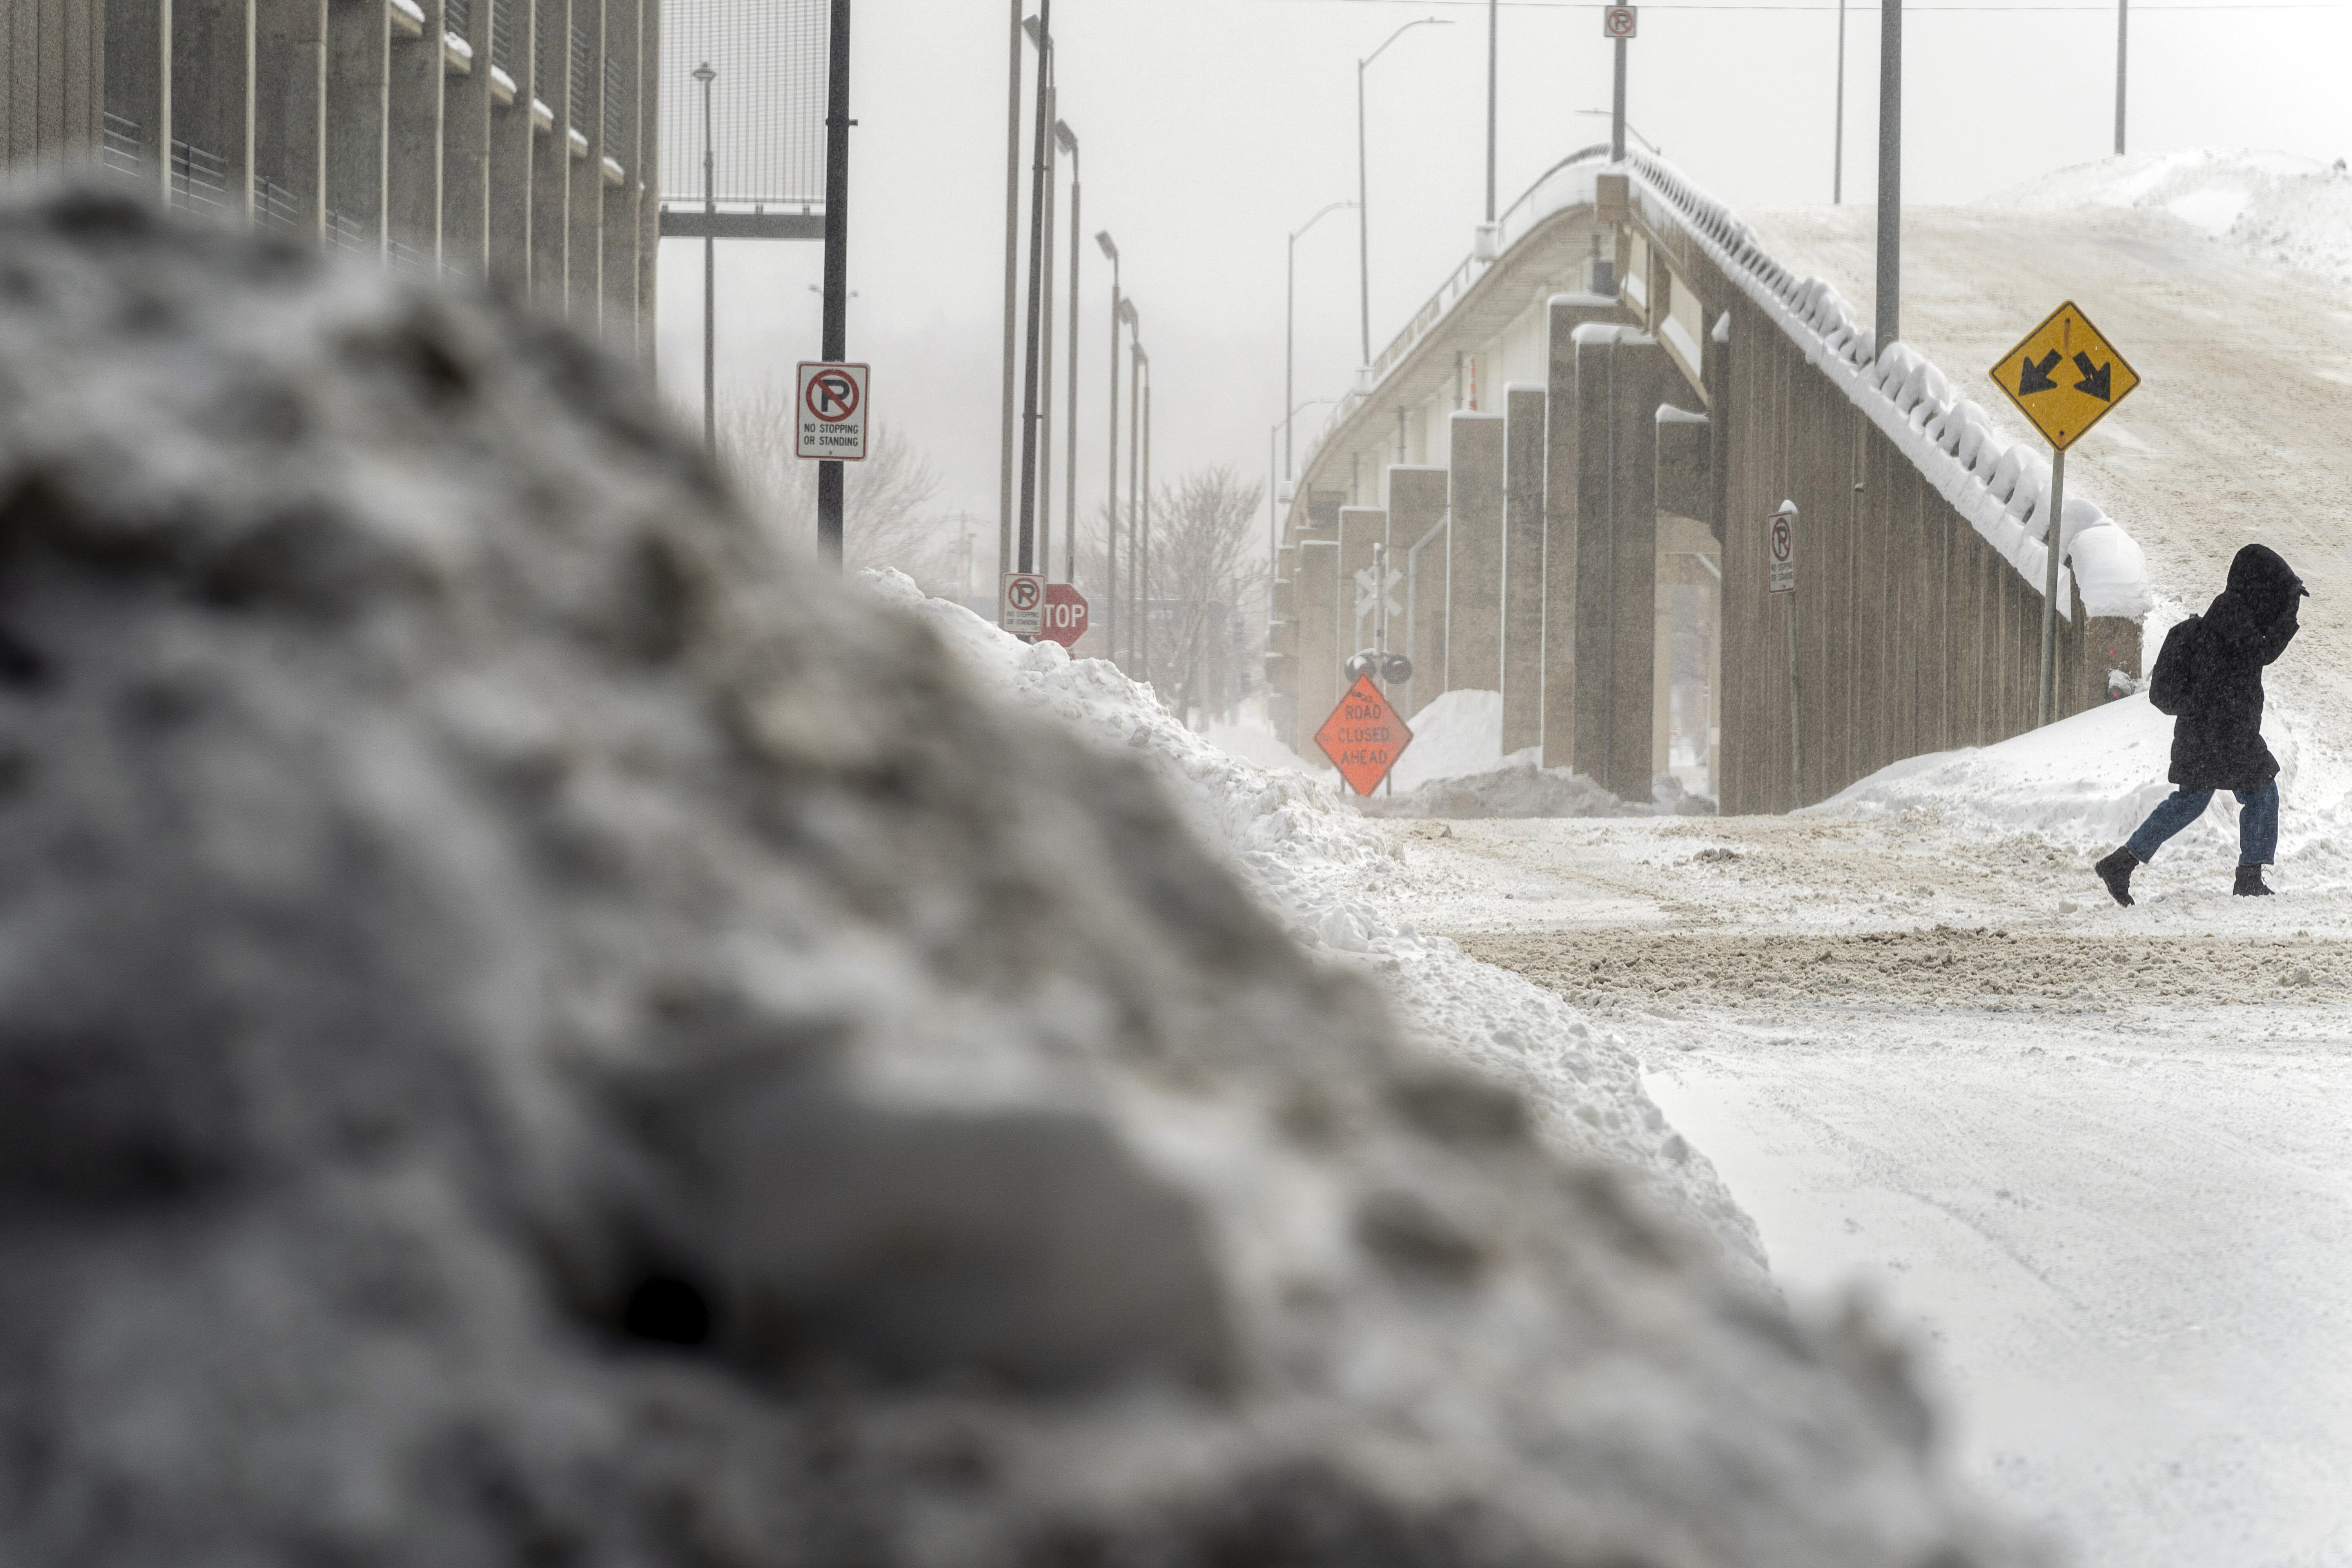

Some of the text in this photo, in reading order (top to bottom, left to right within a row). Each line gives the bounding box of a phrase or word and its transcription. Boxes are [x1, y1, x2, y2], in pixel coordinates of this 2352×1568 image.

[804, 423, 858, 434] NO STOPPING
[804, 436, 858, 446] OR STANDING
[1044, 604, 1085, 628] TOP
[1345, 704, 1381, 720] ROAD
[1338, 727, 1389, 743] CLOSED
[1341, 750, 1387, 764] AHEAD
